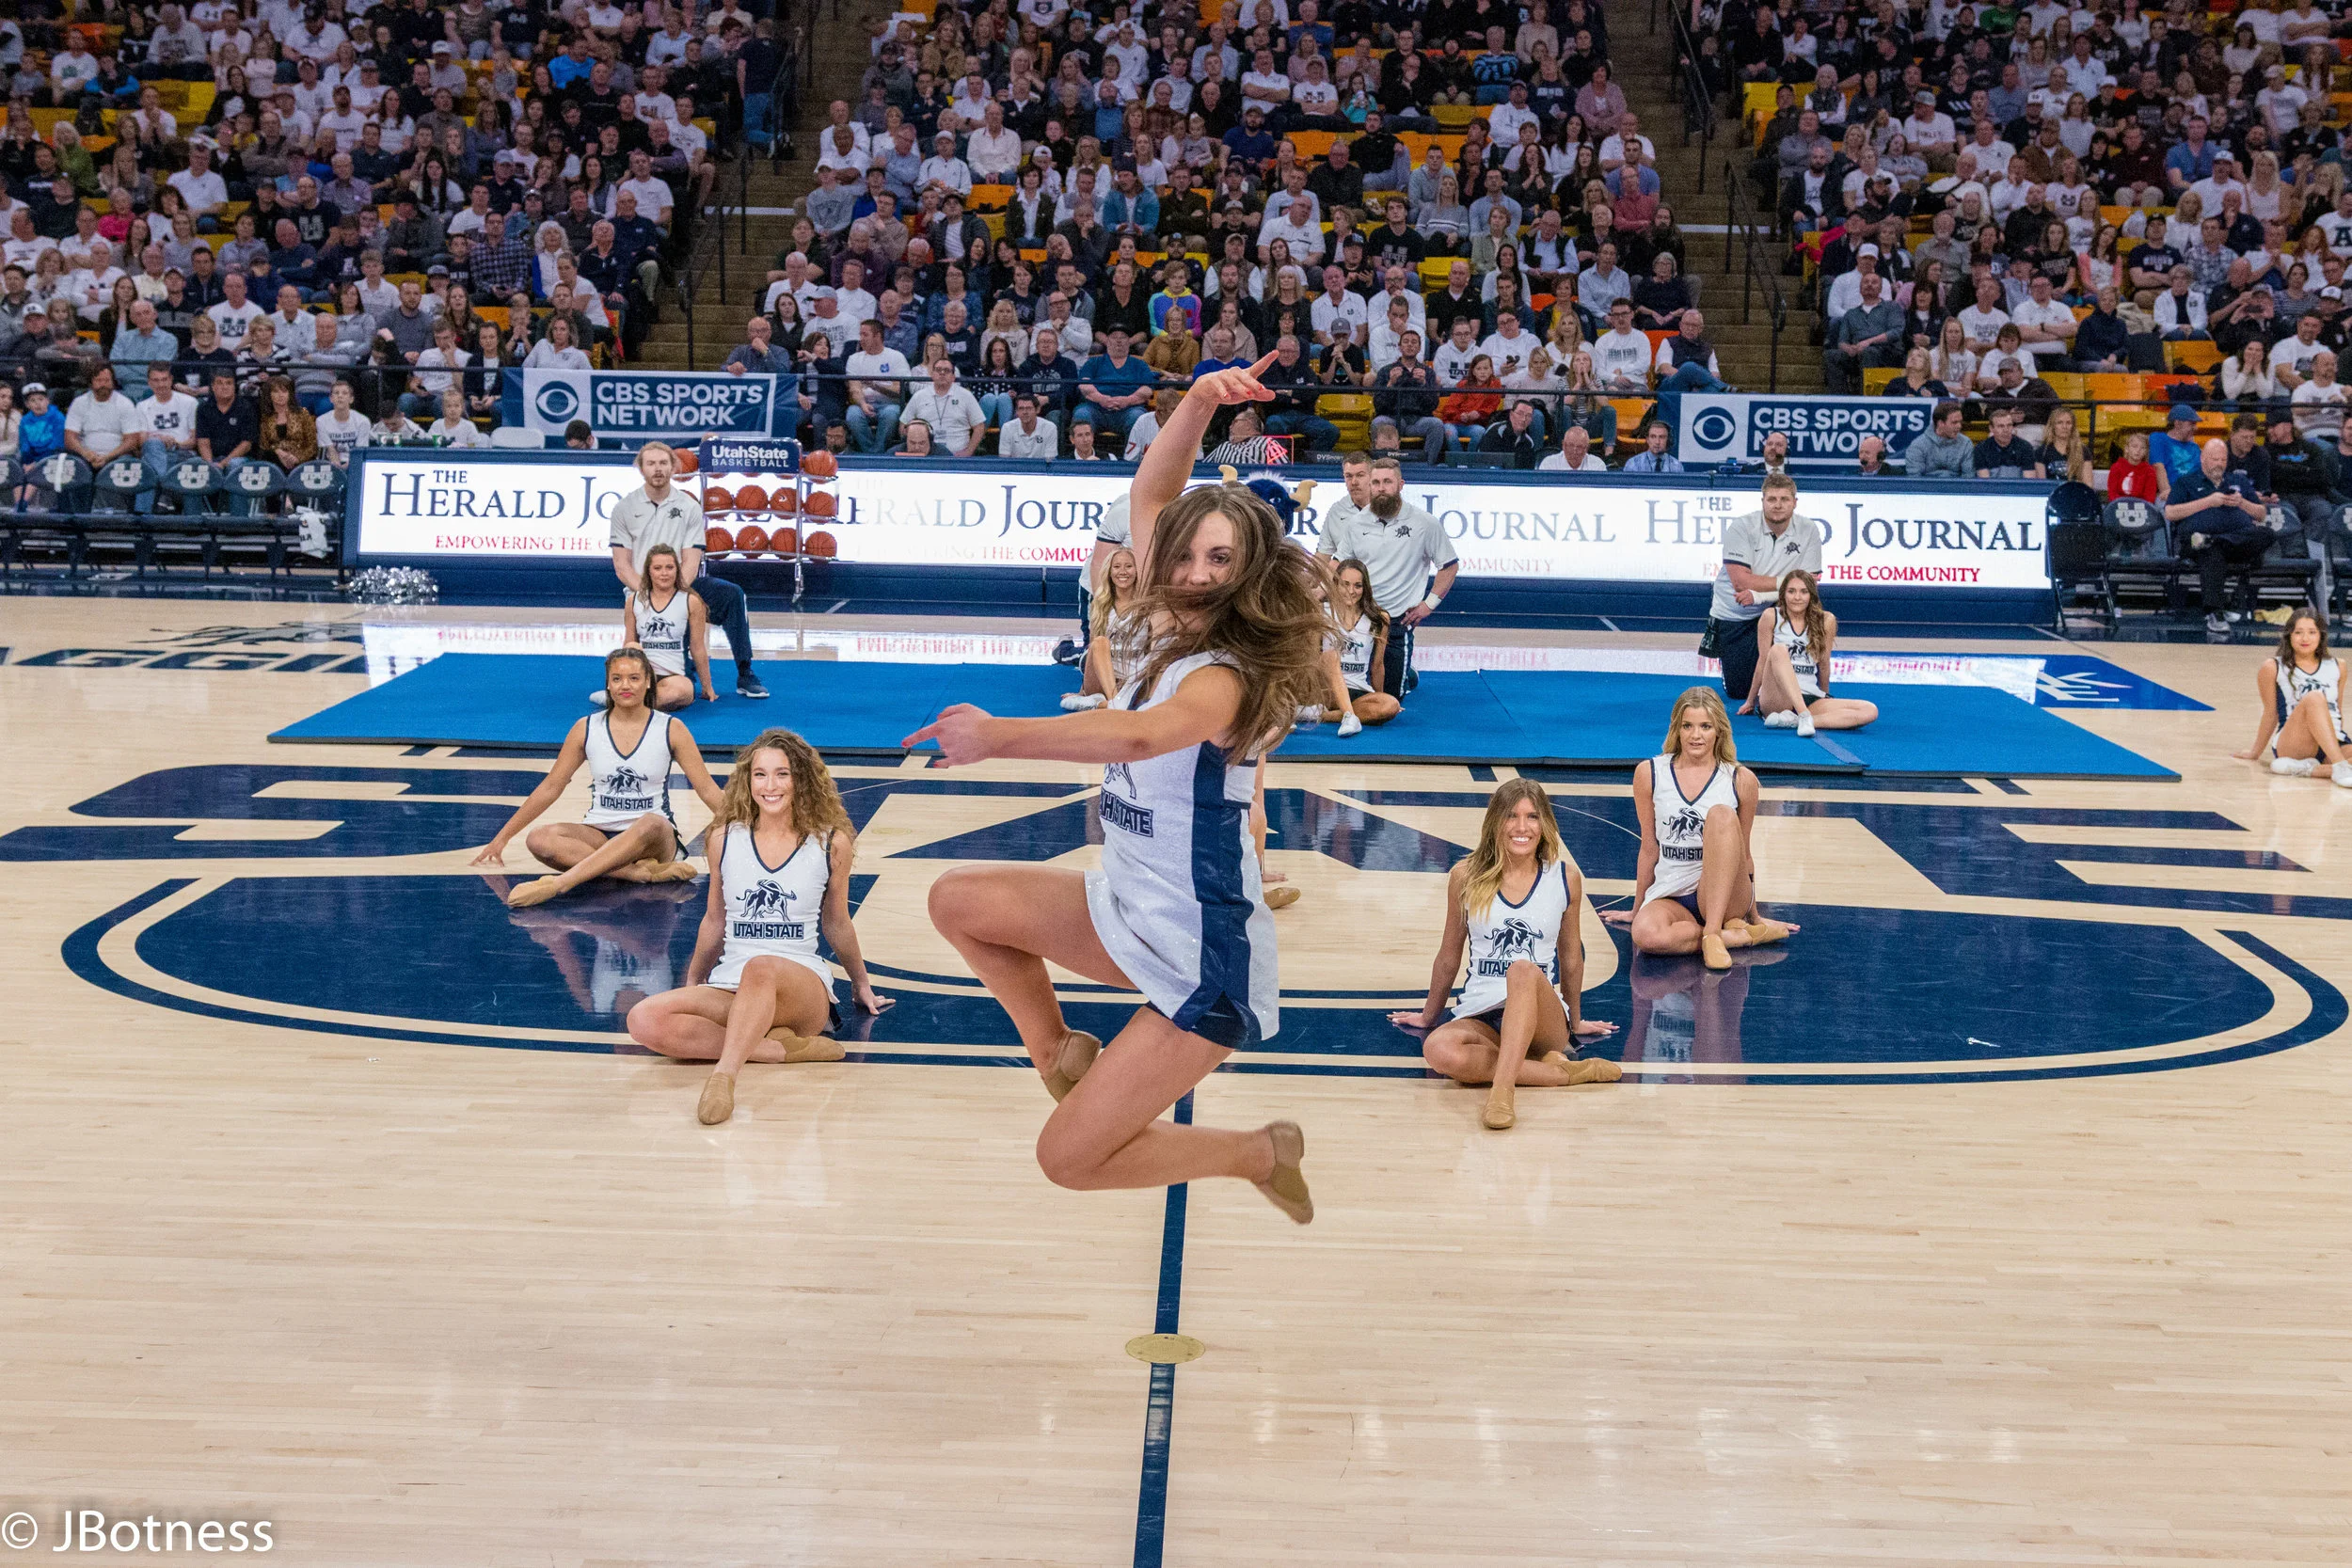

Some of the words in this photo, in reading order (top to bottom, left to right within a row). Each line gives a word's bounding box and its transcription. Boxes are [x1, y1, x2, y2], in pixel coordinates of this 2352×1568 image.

[596, 381, 650, 404] CBS
[656, 383, 764, 405] SPORTS
[596, 404, 736, 426] NETWORK
[1754, 407, 1809, 430] CBS
[1814, 408, 1925, 433] SPORTS
[1753, 429, 1896, 453] NTWOK
[711, 445, 789, 460] UtahState
[711, 457, 789, 468] BASKETBALL
[433, 470, 468, 483] THE
[378, 473, 566, 518] HERALD
[1696, 496, 1732, 512] THE
[997, 484, 1115, 538] JOUR
[1844, 502, 2042, 558] JOURNAL
[436, 535, 553, 551] EMPOWERING
[558, 537, 593, 551] THE
[981, 547, 1014, 561] THE
[1019, 547, 1092, 562] COMMU
[1827, 564, 1863, 580] THE
[1867, 565, 1981, 582] COMMUNITY
[642, 641, 659, 649] UTAH
[659, 641, 681, 650] STATE
[1344, 662, 1366, 673] STATE
[600, 796, 623, 810] UTAH
[624, 796, 654, 811] STATE
[1661, 844, 1686, 861] UTAH
[733, 921, 763, 939] UTAH
[764, 921, 804, 940] STATE
